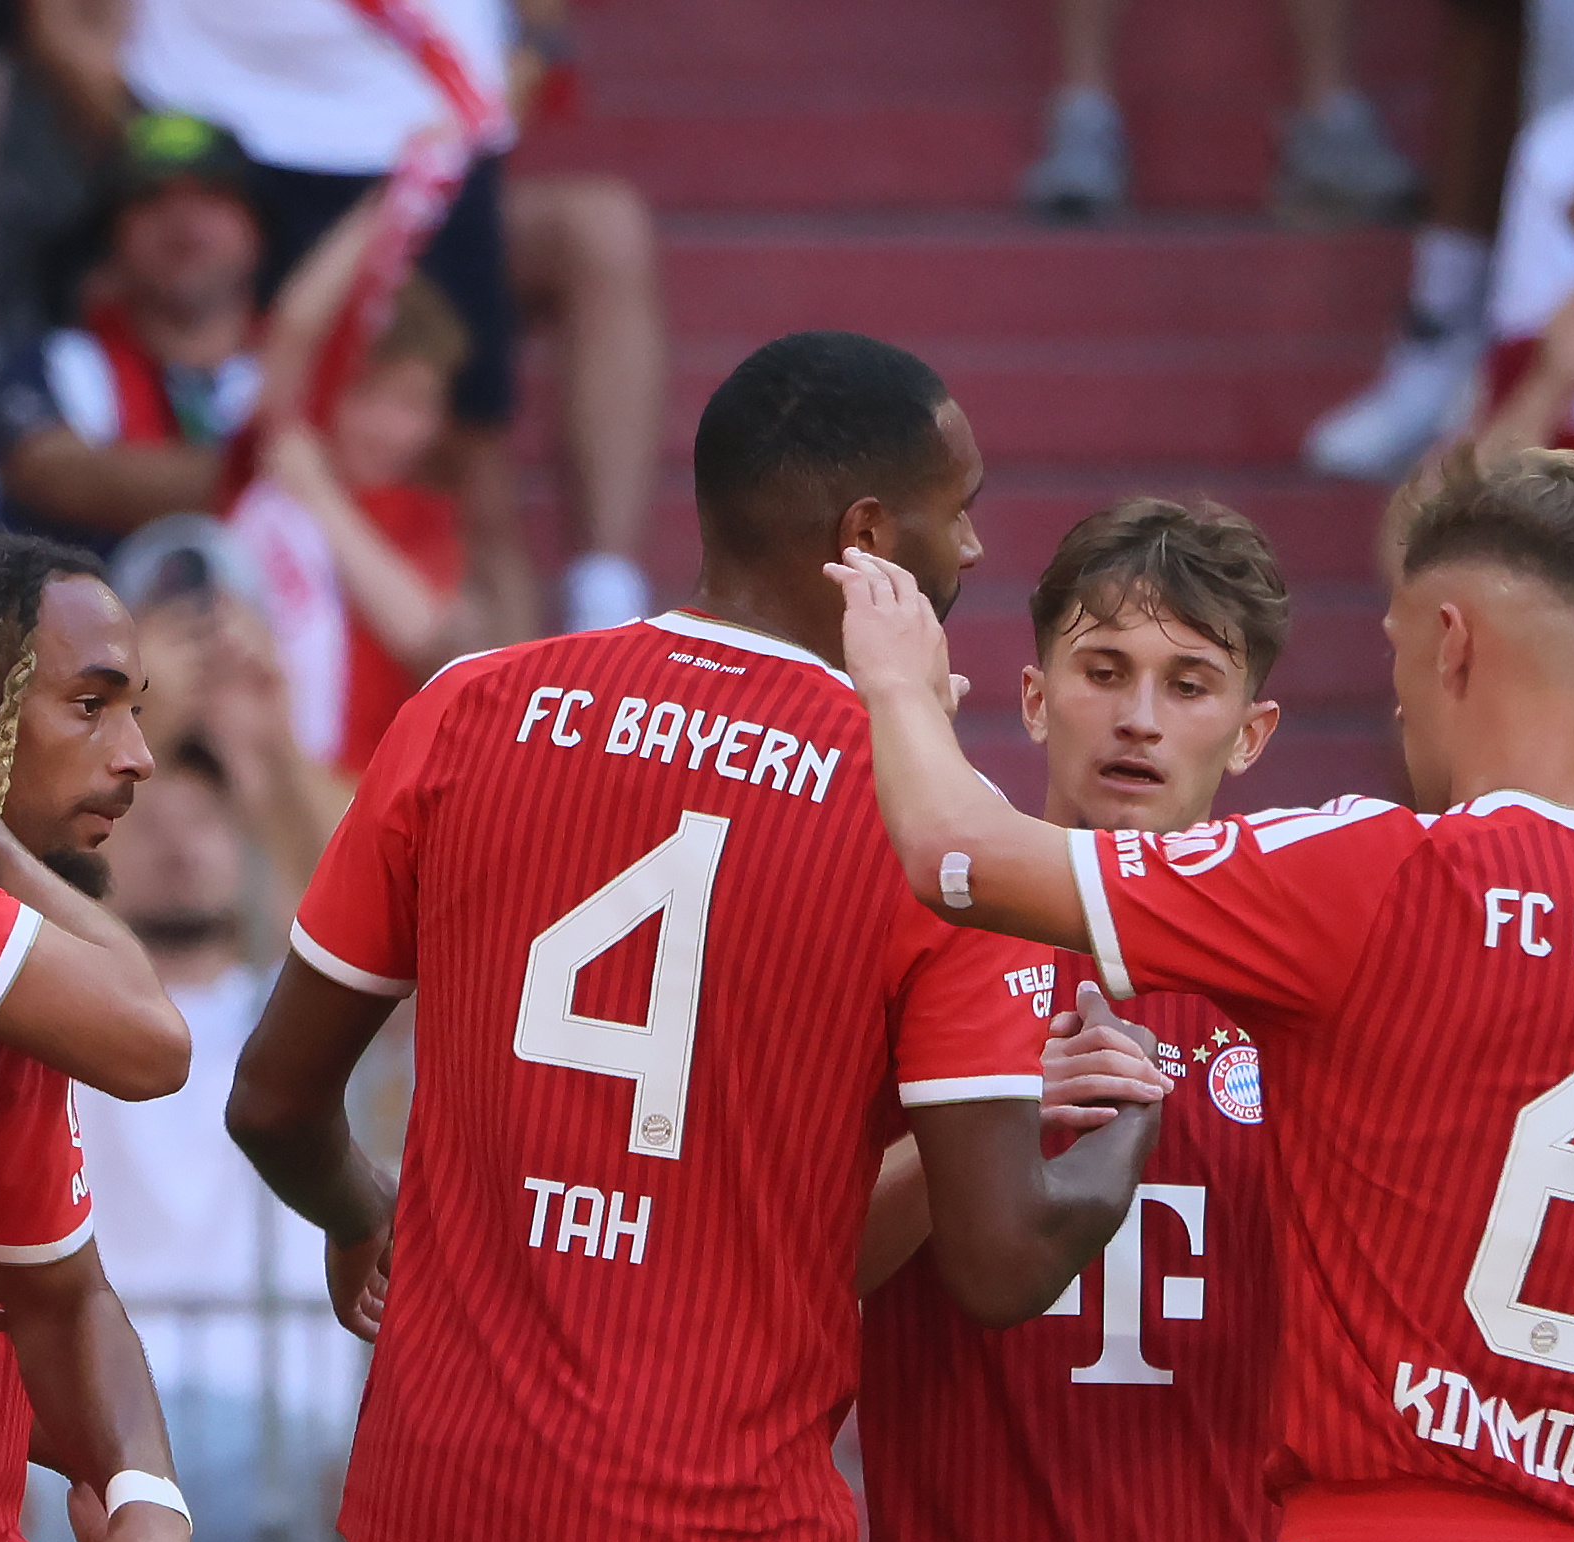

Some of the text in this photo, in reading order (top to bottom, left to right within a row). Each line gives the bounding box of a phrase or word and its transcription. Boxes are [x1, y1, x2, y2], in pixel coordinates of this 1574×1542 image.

[667, 651, 694, 664] MIA
[692, 657, 721, 671] SAN
[516, 686, 841, 804] FC BAYERN
[1484, 887, 1554, 957] FC
[513, 809, 731, 1160] 4
[1003, 963, 1055, 997] TELE
[1157, 1042, 1181, 1060] 026
[1215, 1061, 1230, 1078] FC
[523, 1176, 653, 1265] TAH
